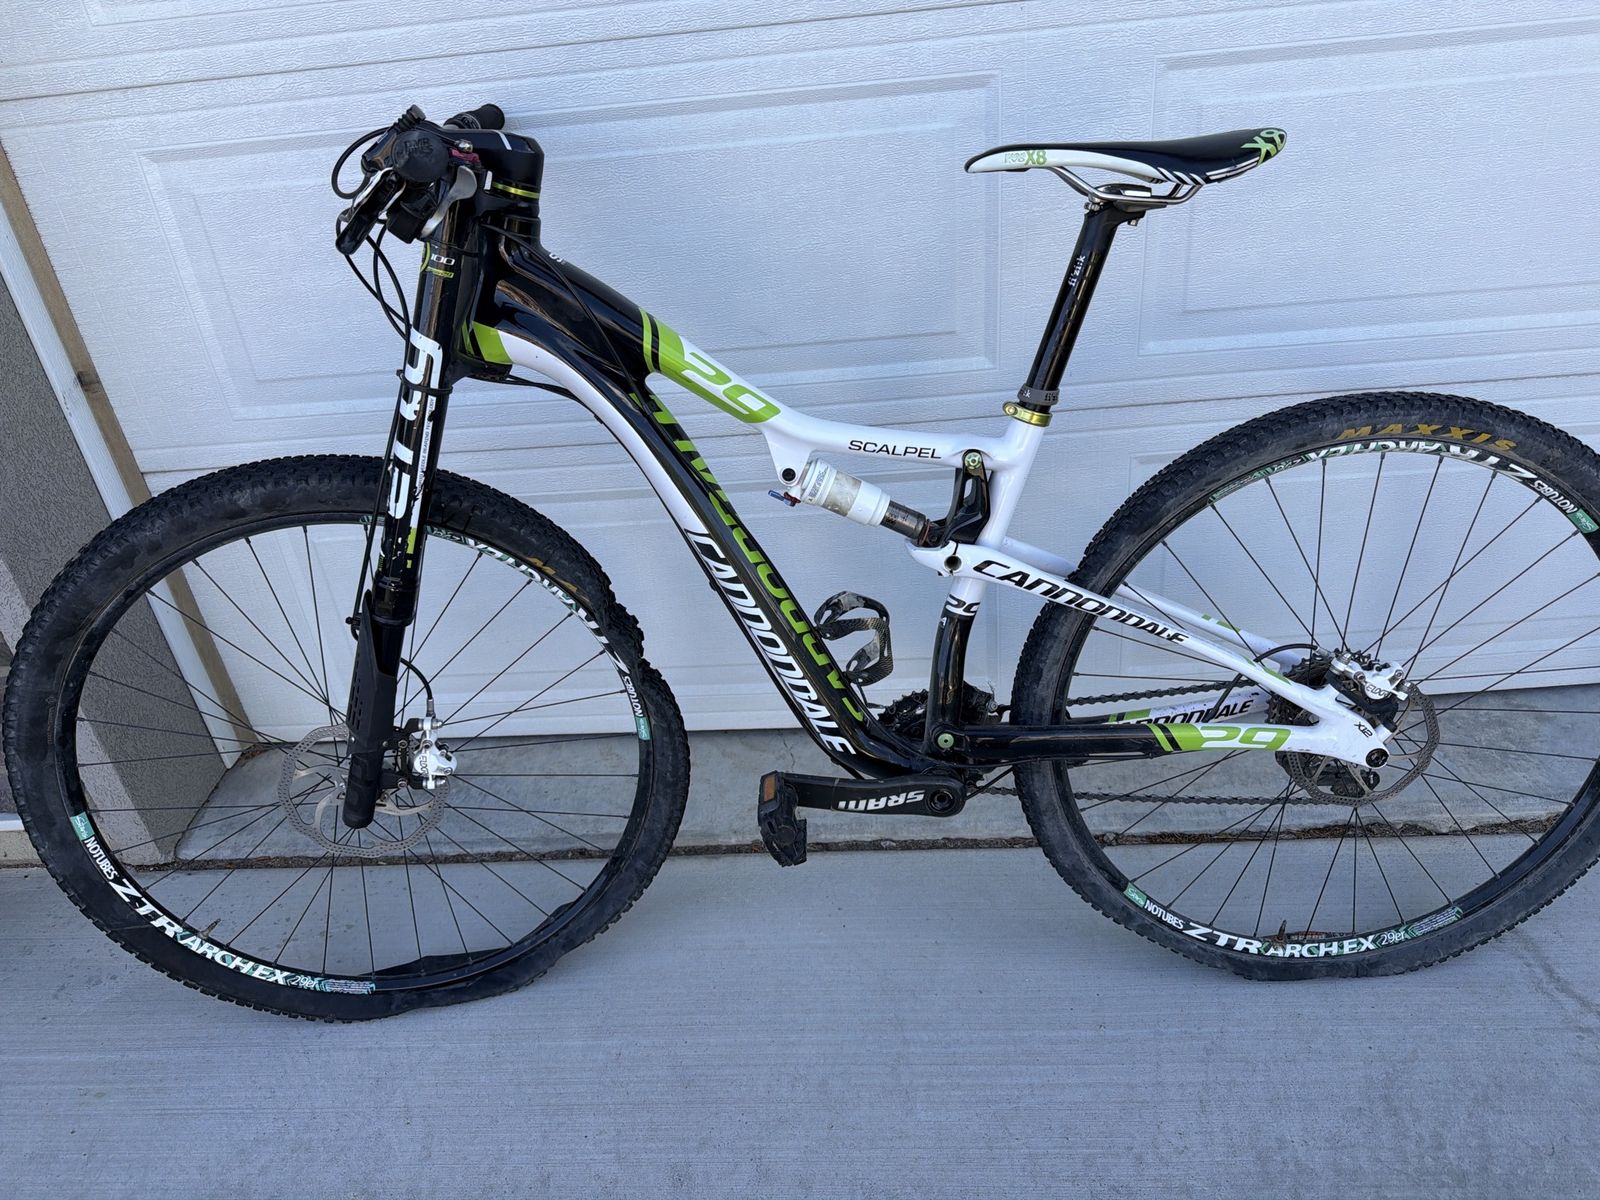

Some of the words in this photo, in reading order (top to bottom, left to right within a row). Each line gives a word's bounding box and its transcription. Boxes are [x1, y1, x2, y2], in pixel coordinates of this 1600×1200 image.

[848, 439, 942, 460] SCALPEL
[1335, 423, 1517, 451] MAXXIS
[1531, 479, 1579, 514] NOTUBES
[973, 560, 1189, 644] CANNONDALE
[694, 531, 857, 756] CANNONDALE
[1200, 725, 1292, 751] 29
[1353, 720, 1374, 739] X12
[838, 790, 925, 811] SRAM
[84, 836, 118, 880] NOTUBES
[108, 878, 184, 938] ZTR
[1144, 900, 1184, 930] NOTUBES
[1182, 922, 1263, 954] ZTR
